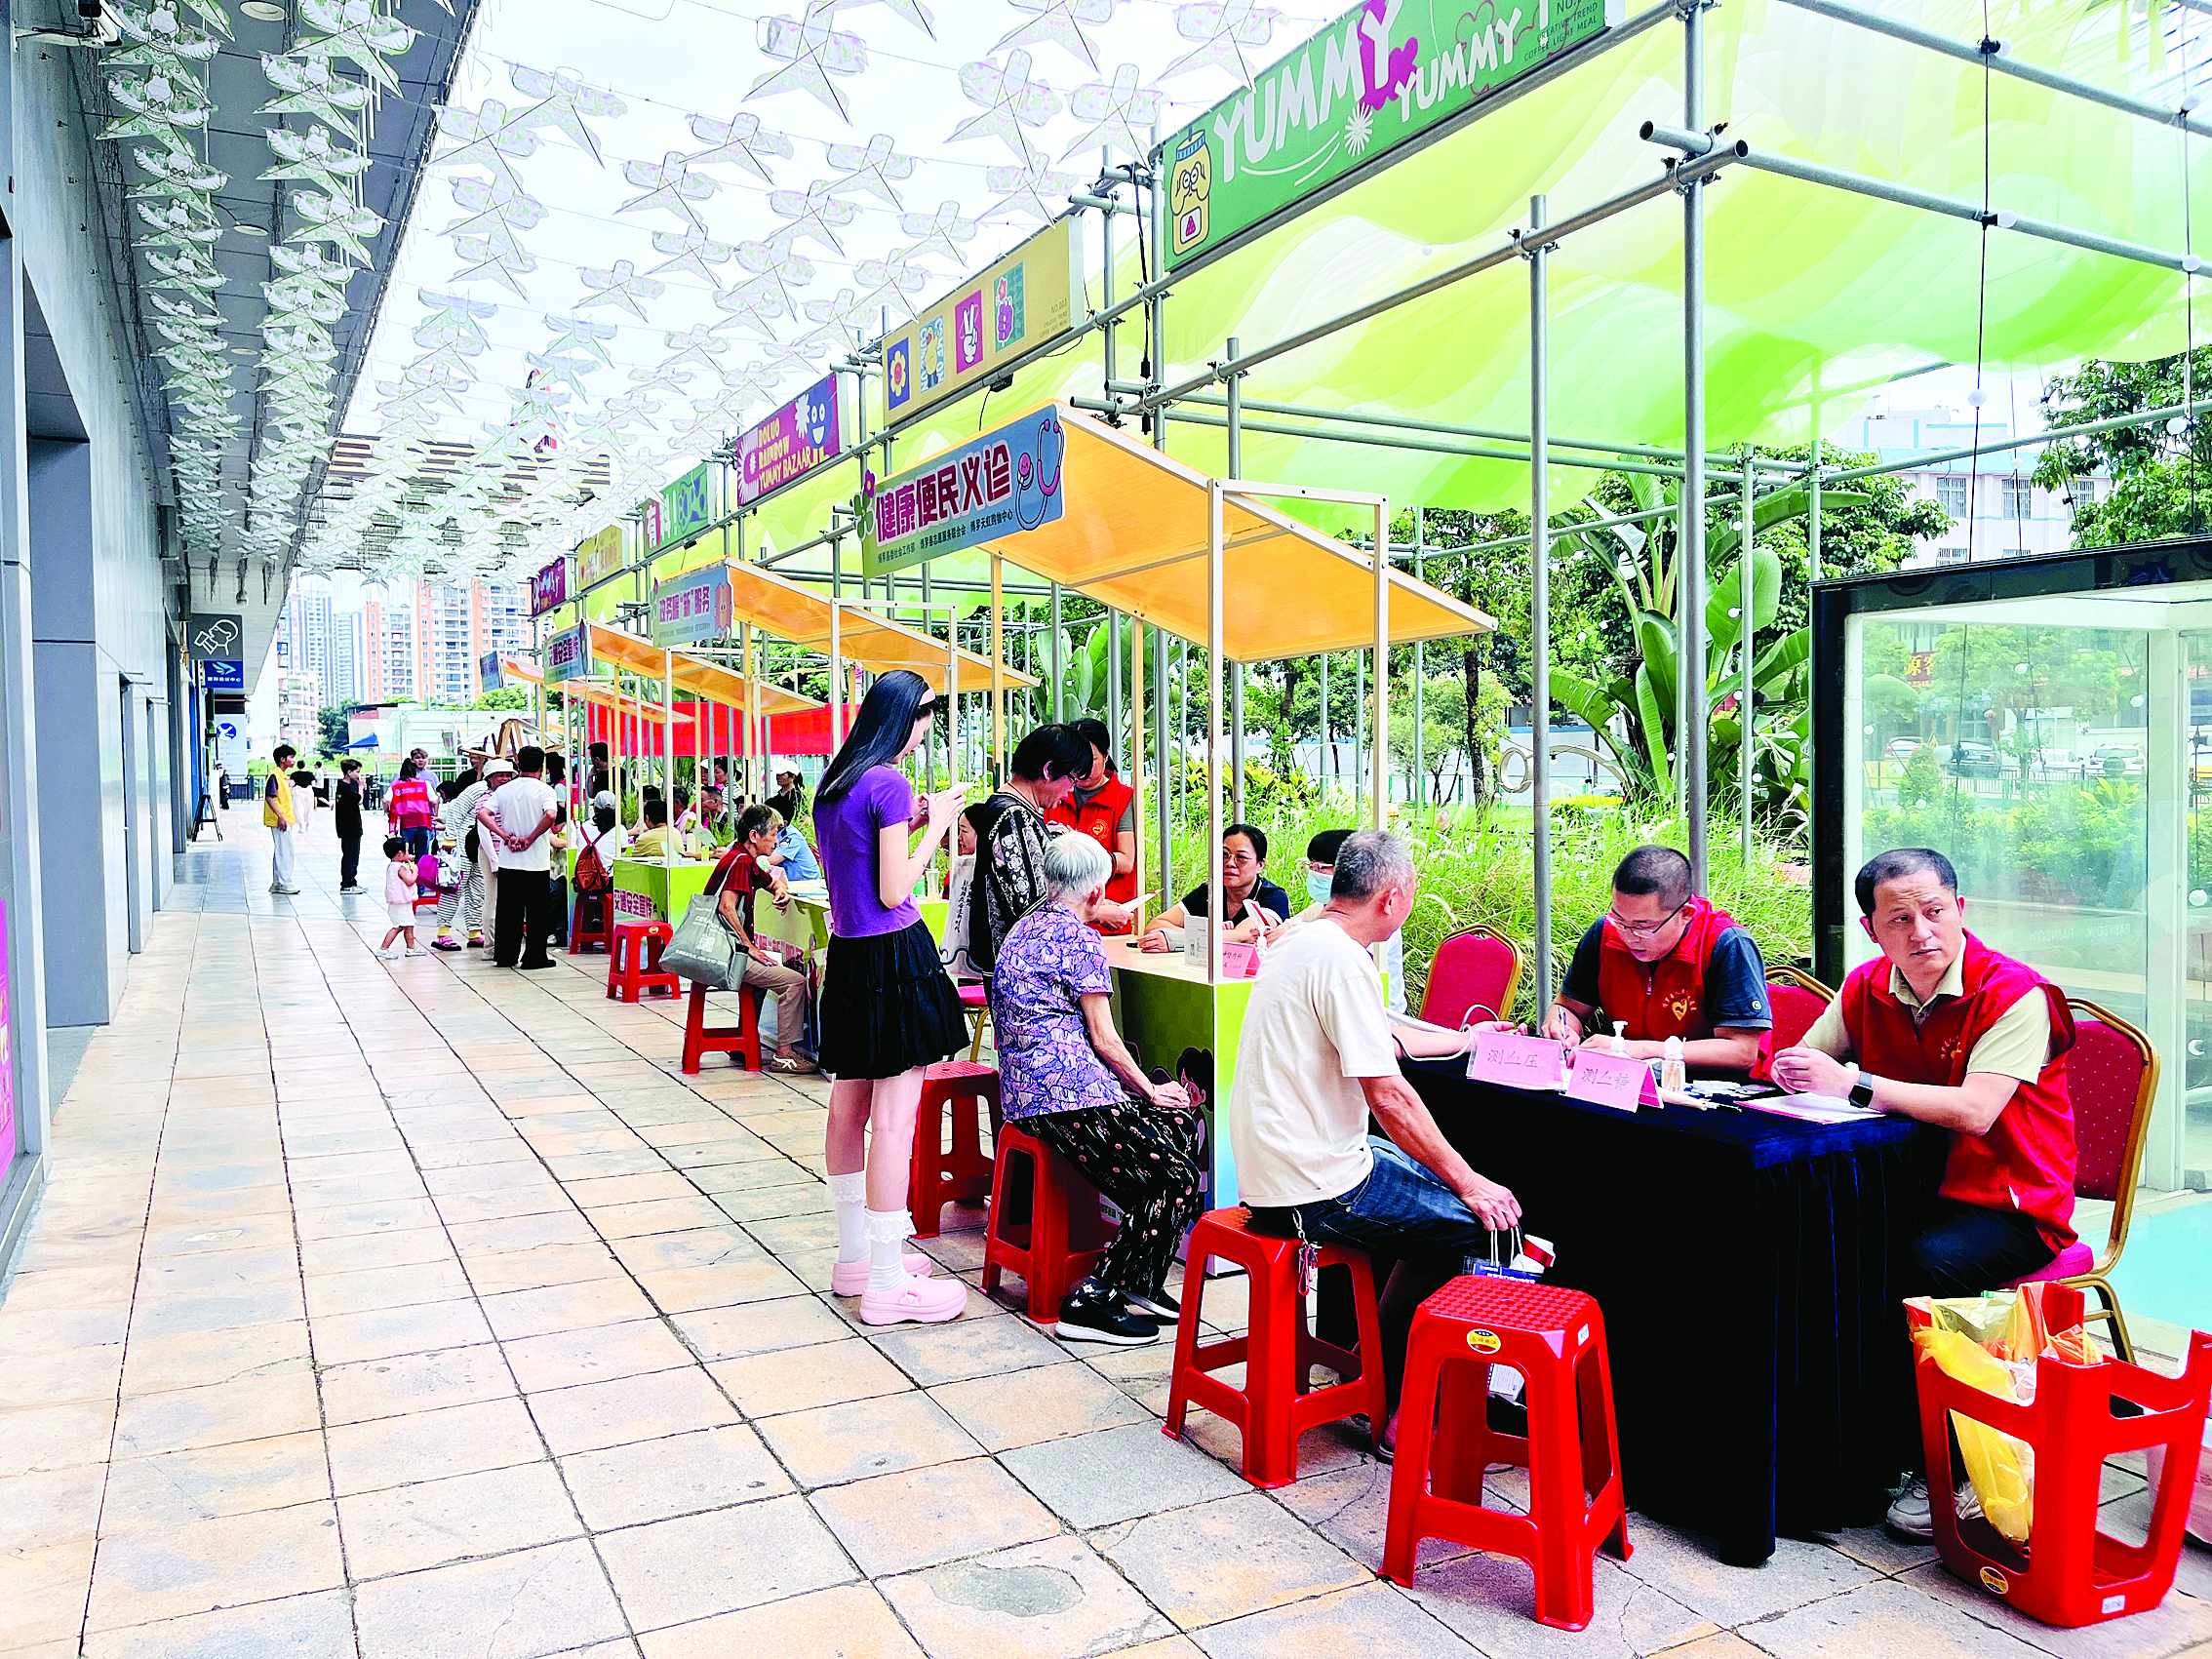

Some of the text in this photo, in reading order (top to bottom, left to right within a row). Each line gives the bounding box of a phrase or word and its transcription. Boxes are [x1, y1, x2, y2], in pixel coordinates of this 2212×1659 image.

[1573, 2, 1598, 21] TREND
[1523, 16, 1598, 61] COFFEE LIGHT MEAL
[1213, 0, 1402, 183] YUMMY
[758, 417, 780, 449] BOLUO
[758, 435, 790, 470] RAINBOW
[759, 446, 811, 492] YUMMY BAZAAR
[876, 444, 1011, 543] 健康便民义诊
[970, 508, 1013, 533] 博罗天虹购物中心
[613, 889, 652, 919] 交通安全宣传
[1486, 1048, 1539, 1068] 测血压
[1581, 1067, 1631, 1090] 测血糖
